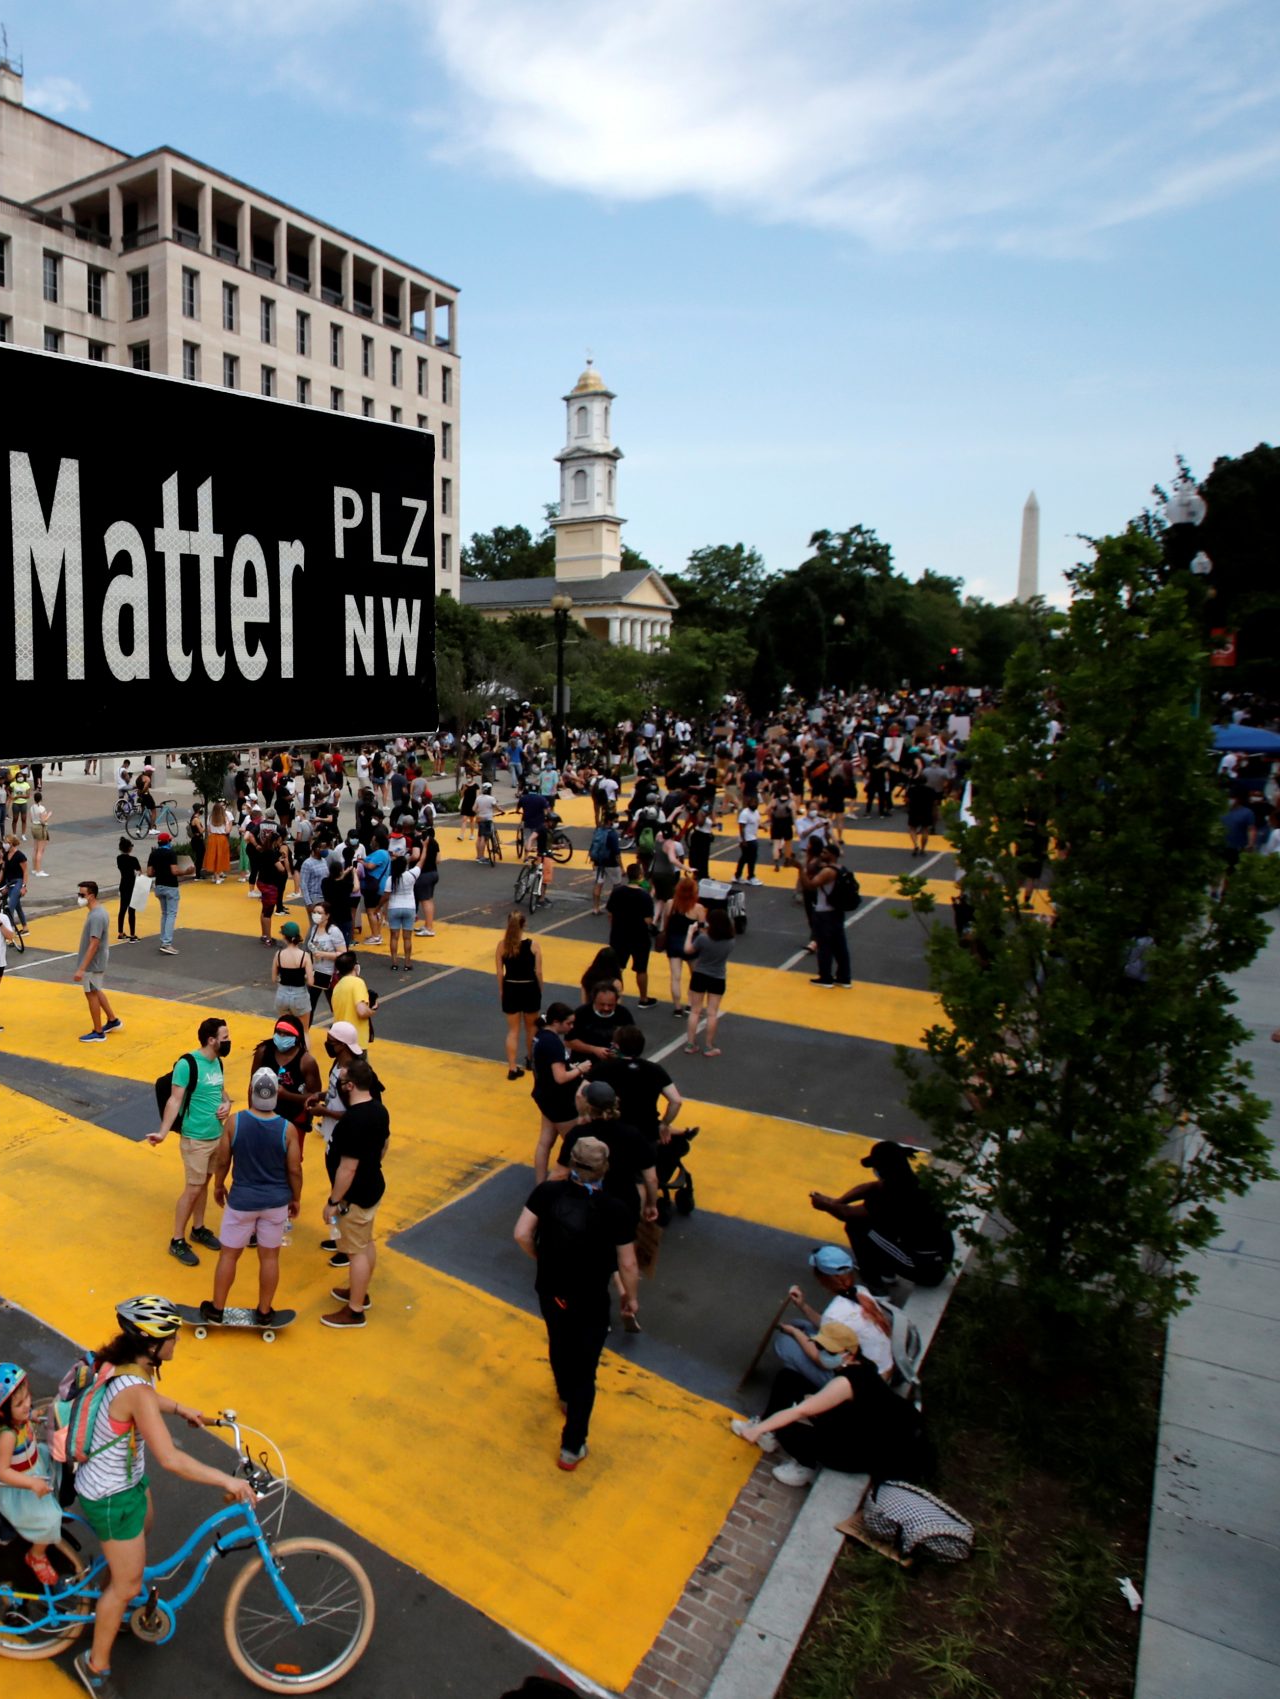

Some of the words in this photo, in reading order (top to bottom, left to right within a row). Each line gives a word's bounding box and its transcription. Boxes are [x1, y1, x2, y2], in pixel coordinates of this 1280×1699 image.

[9, 450, 305, 682] Matter
[334, 486, 429, 568] PLZ
[345, 594, 422, 677] NW
